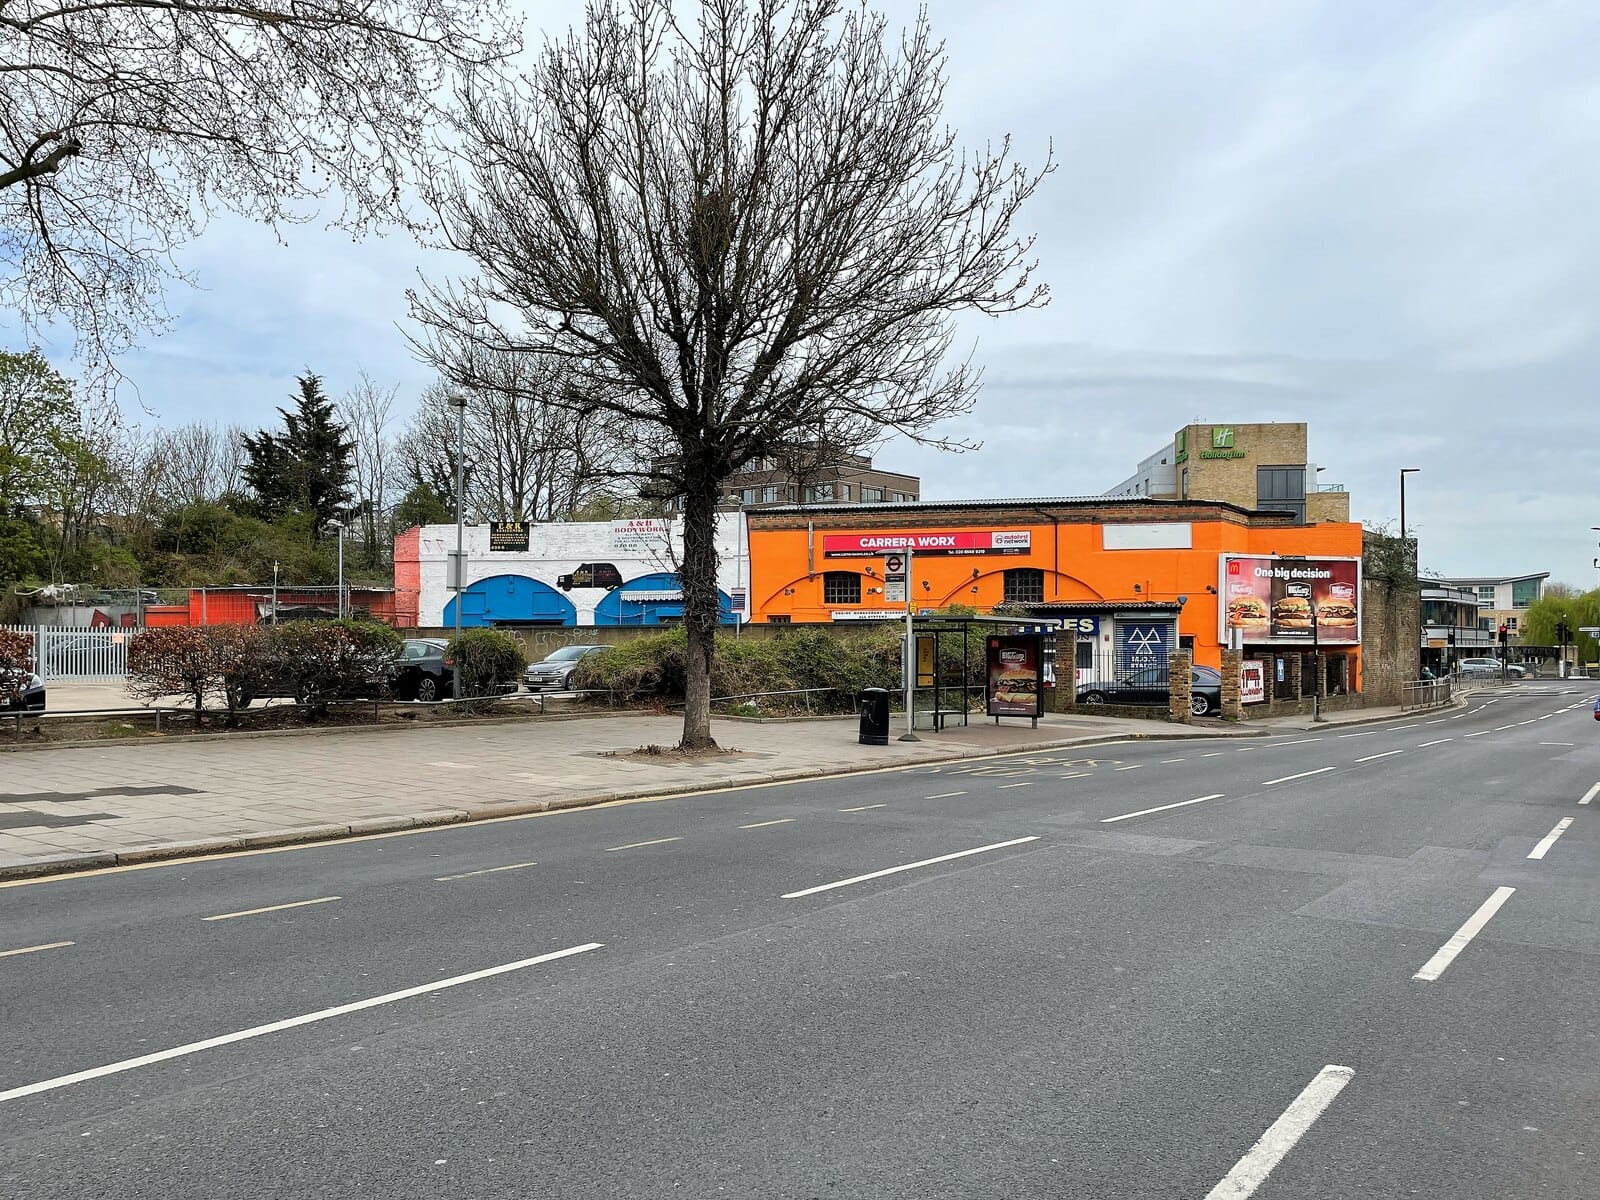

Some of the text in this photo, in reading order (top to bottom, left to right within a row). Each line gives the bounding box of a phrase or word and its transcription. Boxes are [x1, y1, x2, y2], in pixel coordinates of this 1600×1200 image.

[860, 536, 956, 547] CARRERA WORX
[1254, 567, 1331, 580] One big decision
